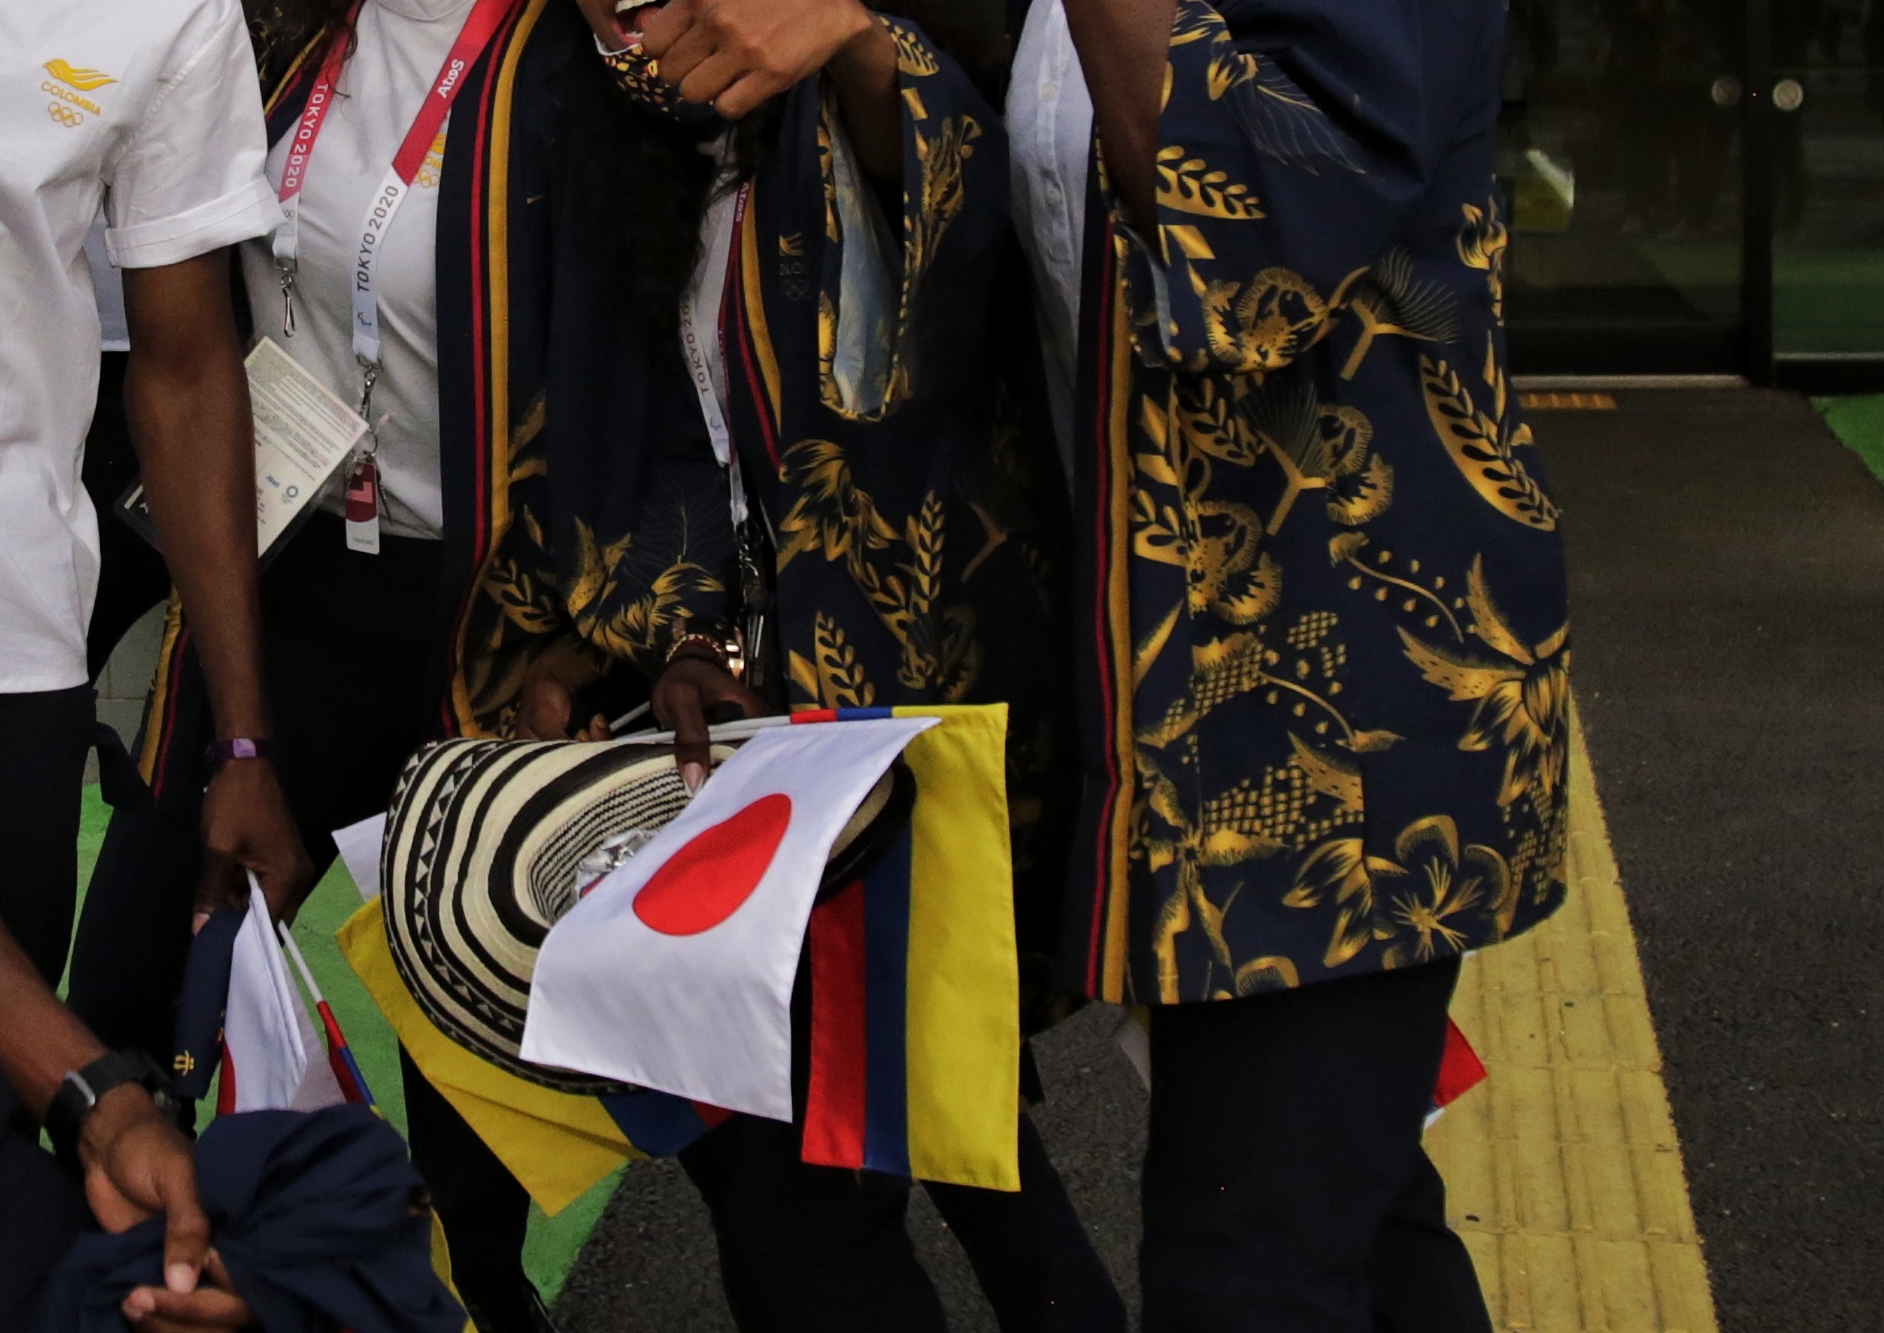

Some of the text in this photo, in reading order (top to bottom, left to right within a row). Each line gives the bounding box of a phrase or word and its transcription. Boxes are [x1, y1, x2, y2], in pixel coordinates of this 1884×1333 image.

[41, 81, 101, 117] COLOMBIA
[437, 59, 465, 99] Atos
[285, 83, 328, 188] TOKYO 2020
[356, 186, 399, 293] TOKYO 2020
[685, 332, 709, 396] TOKYO
